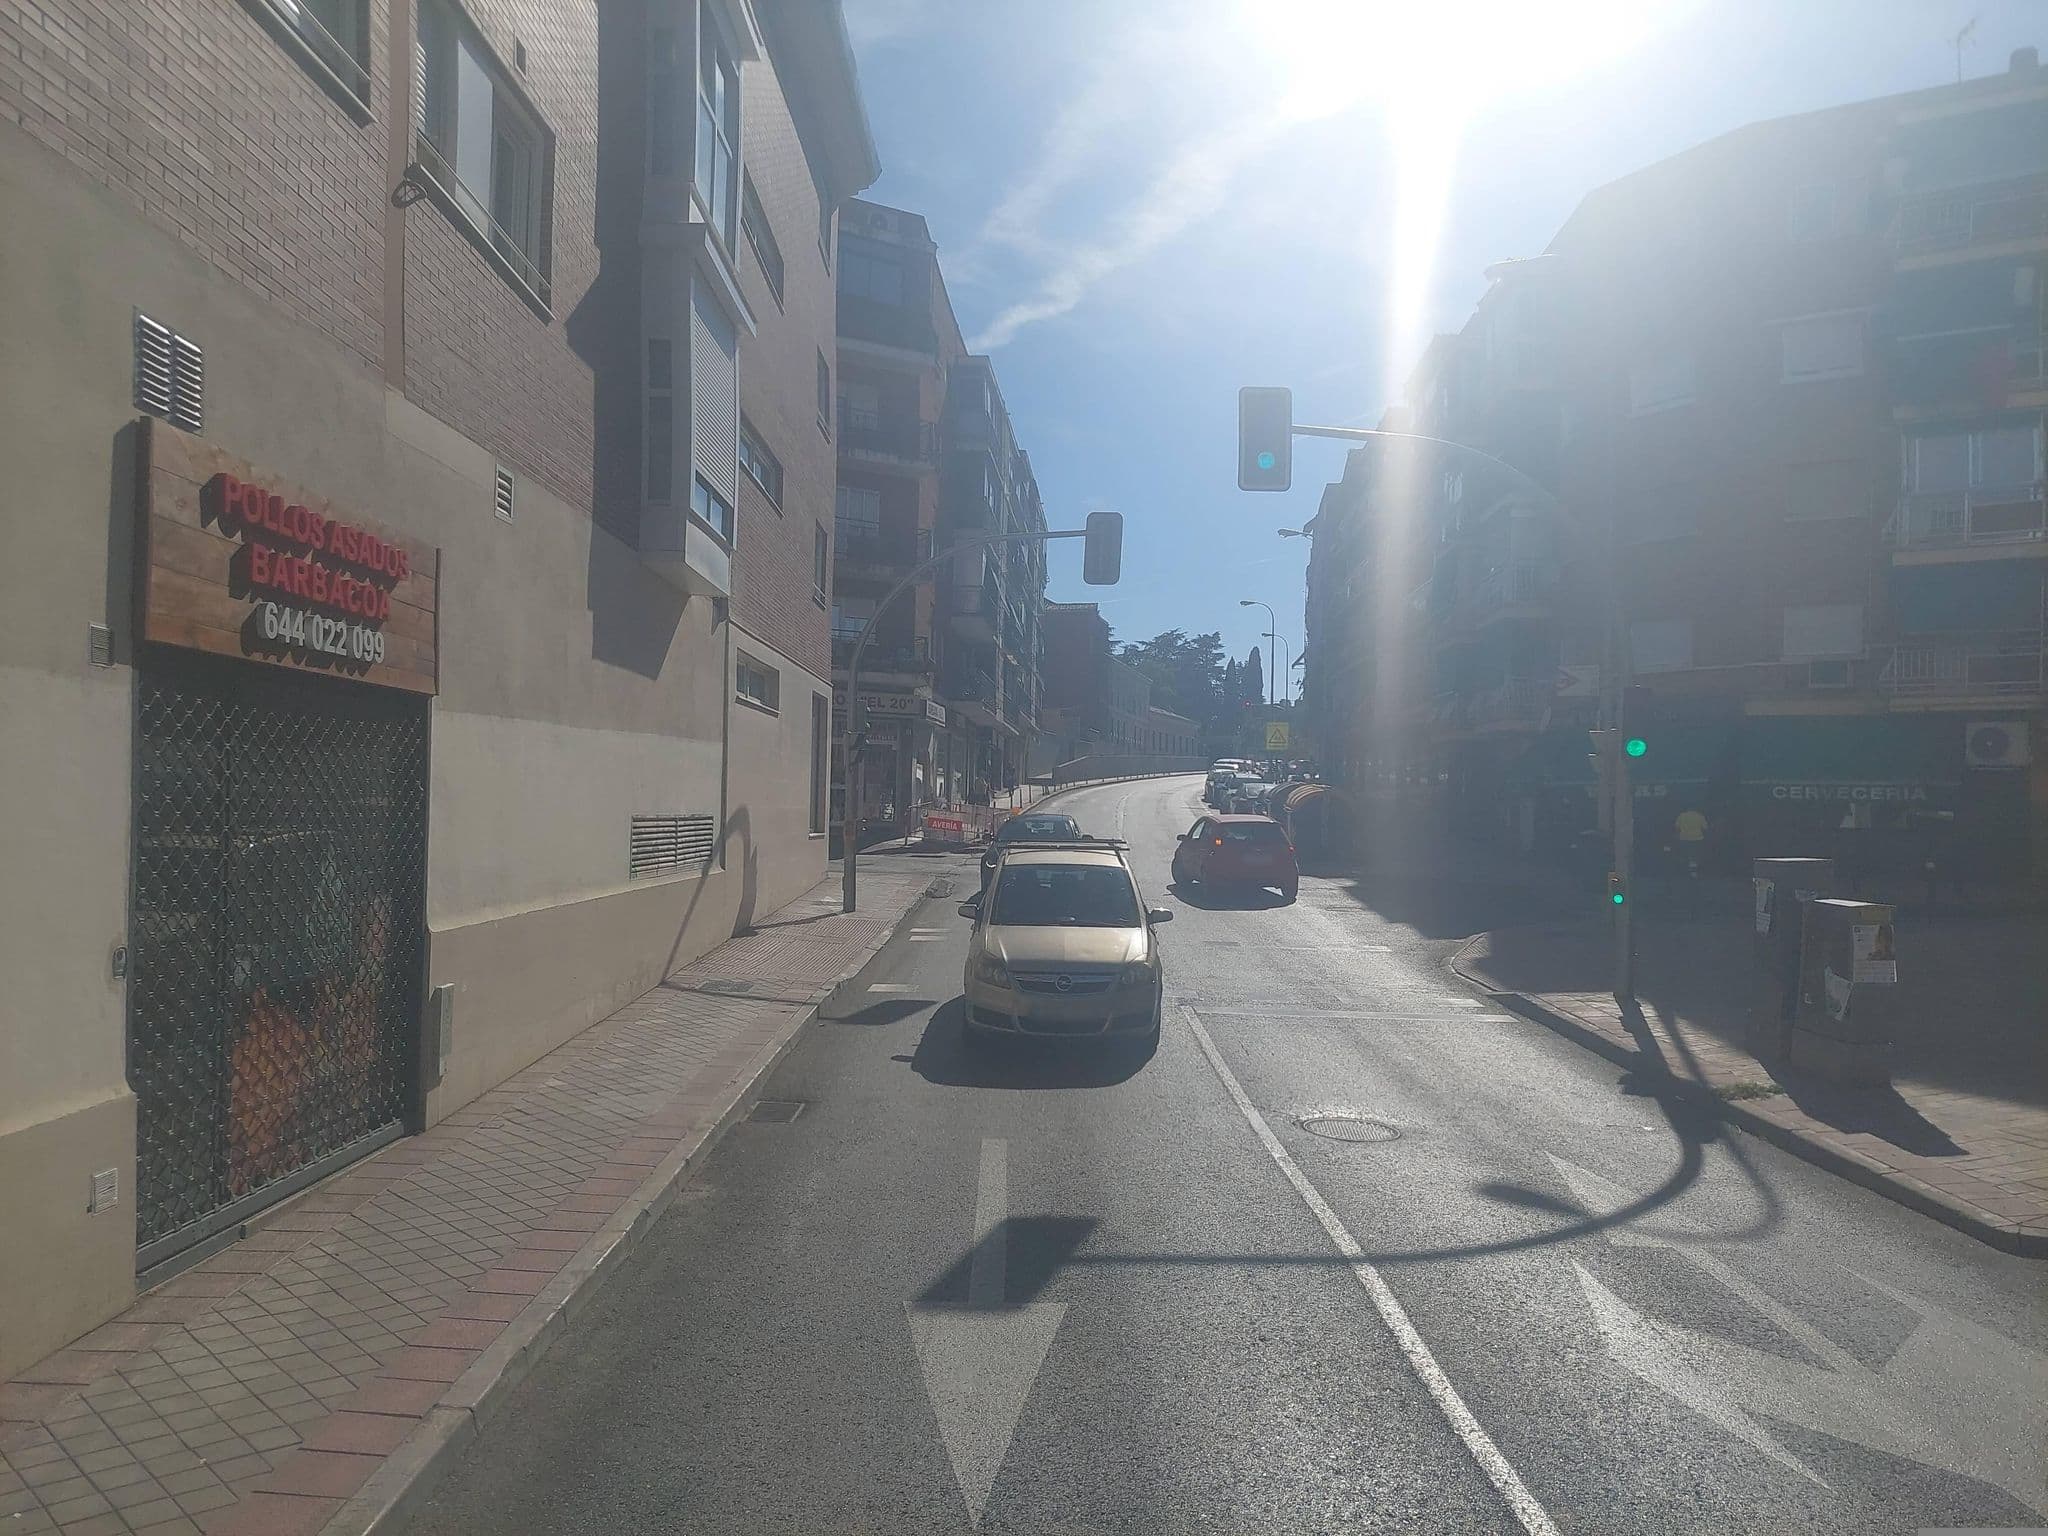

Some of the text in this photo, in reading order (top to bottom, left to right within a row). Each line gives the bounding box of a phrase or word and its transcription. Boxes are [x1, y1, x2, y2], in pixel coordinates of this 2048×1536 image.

[222, 475, 409, 580] POLLOS ASADOS
[251, 544, 391, 623] BARBACOA
[264, 602, 385, 663] 644 022 099
[932, 818, 958, 831] AVERÍA
